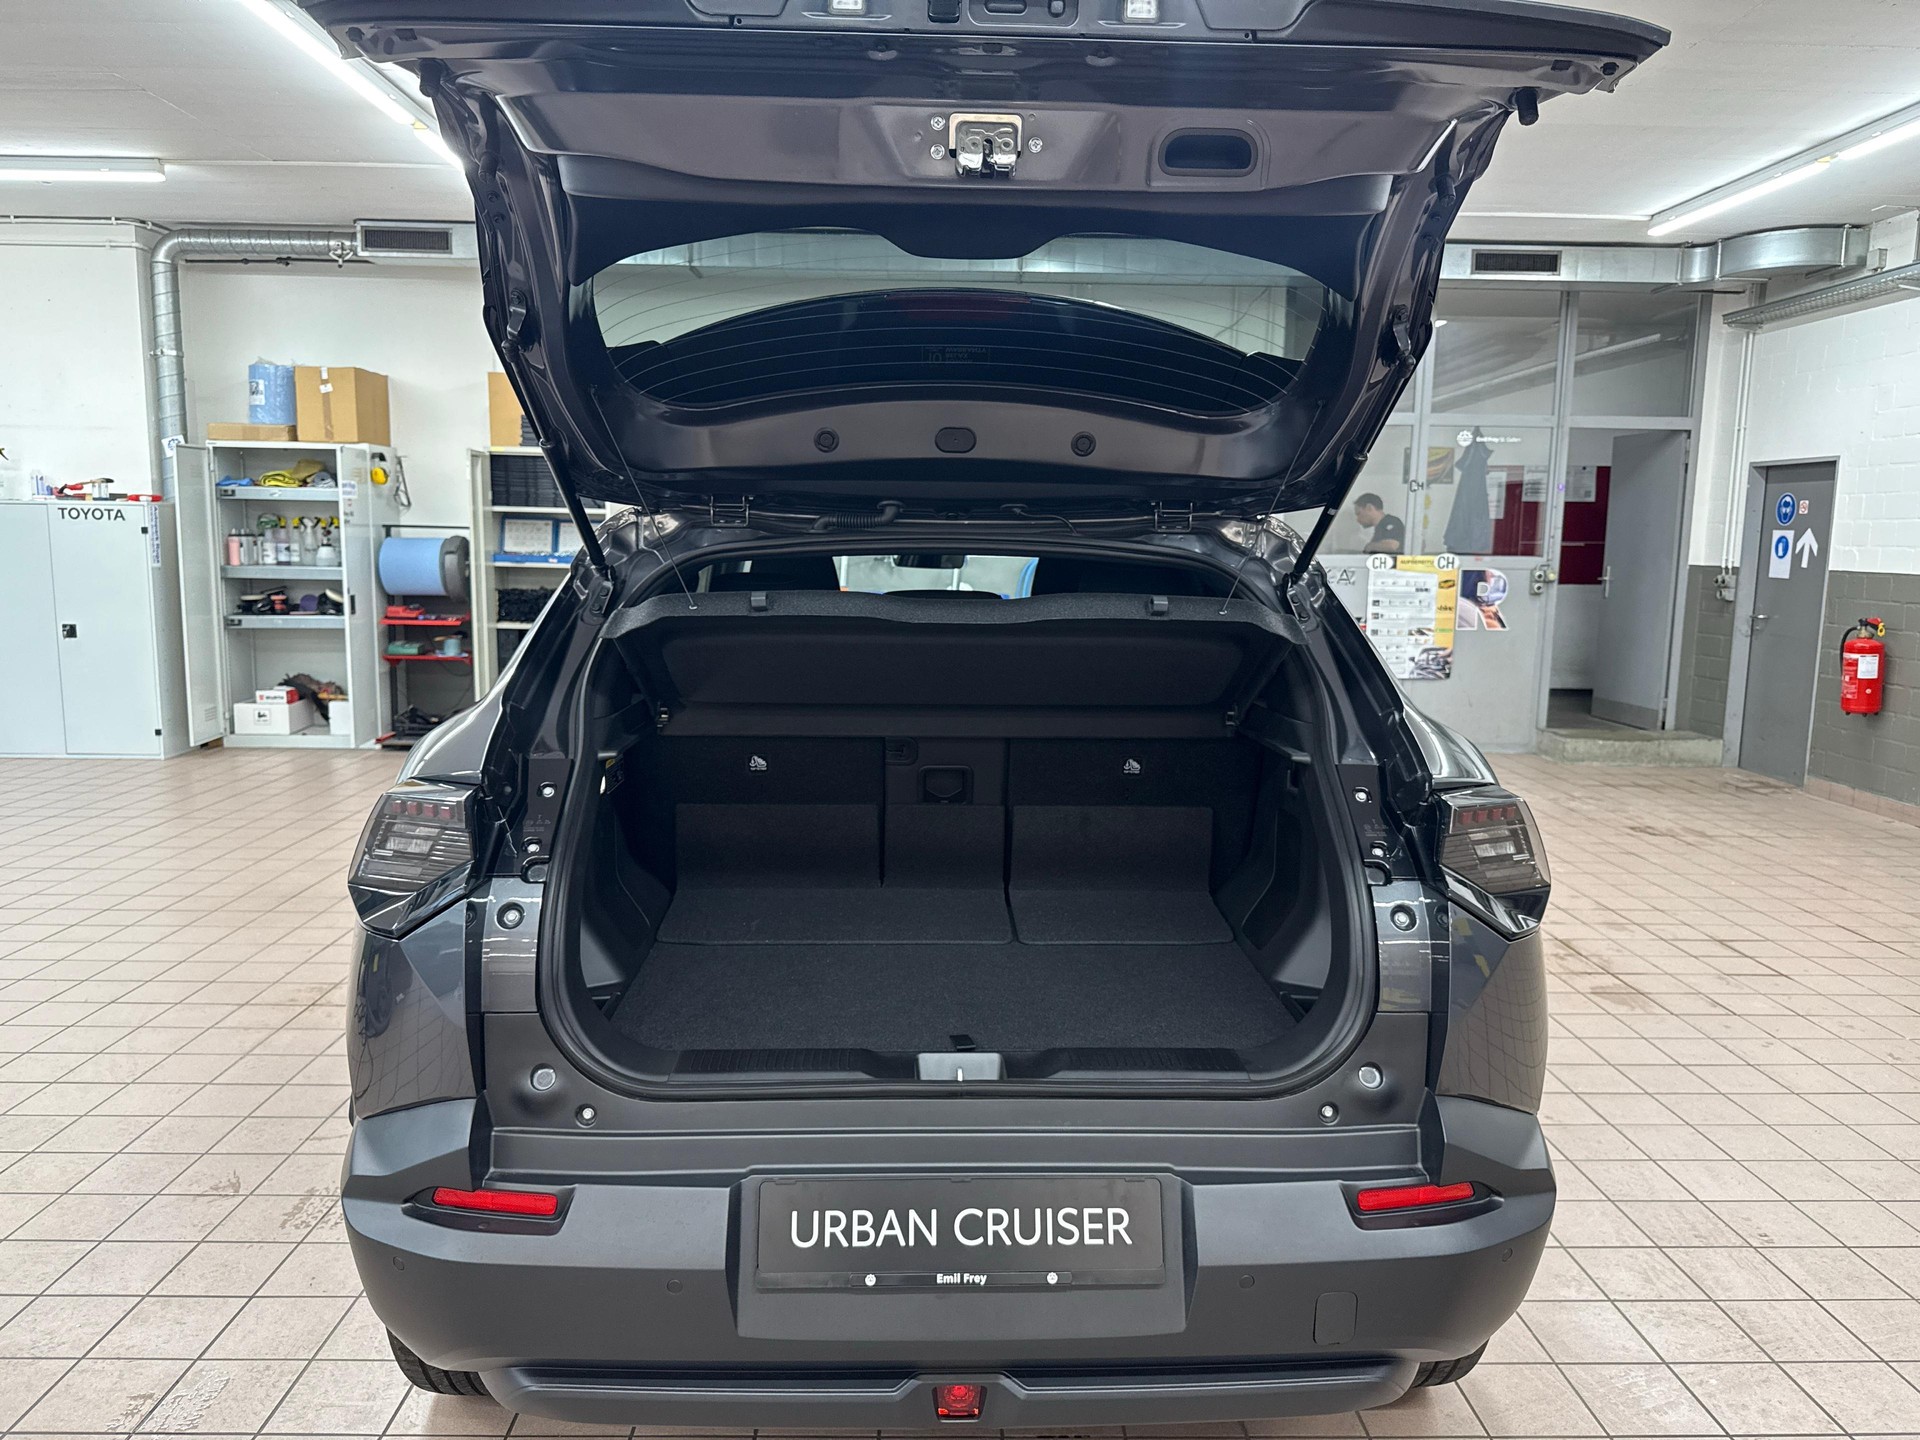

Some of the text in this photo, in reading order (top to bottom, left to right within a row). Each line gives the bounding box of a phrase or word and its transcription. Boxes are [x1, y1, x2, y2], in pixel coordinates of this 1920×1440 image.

[58, 507, 126, 521] TOYOTA
[1372, 557, 1387, 570] CH
[1437, 556, 1455, 570] CH
[789, 1206, 1133, 1249] URBAN CRUISER
[936, 1272, 988, 1286] Emil Frey
